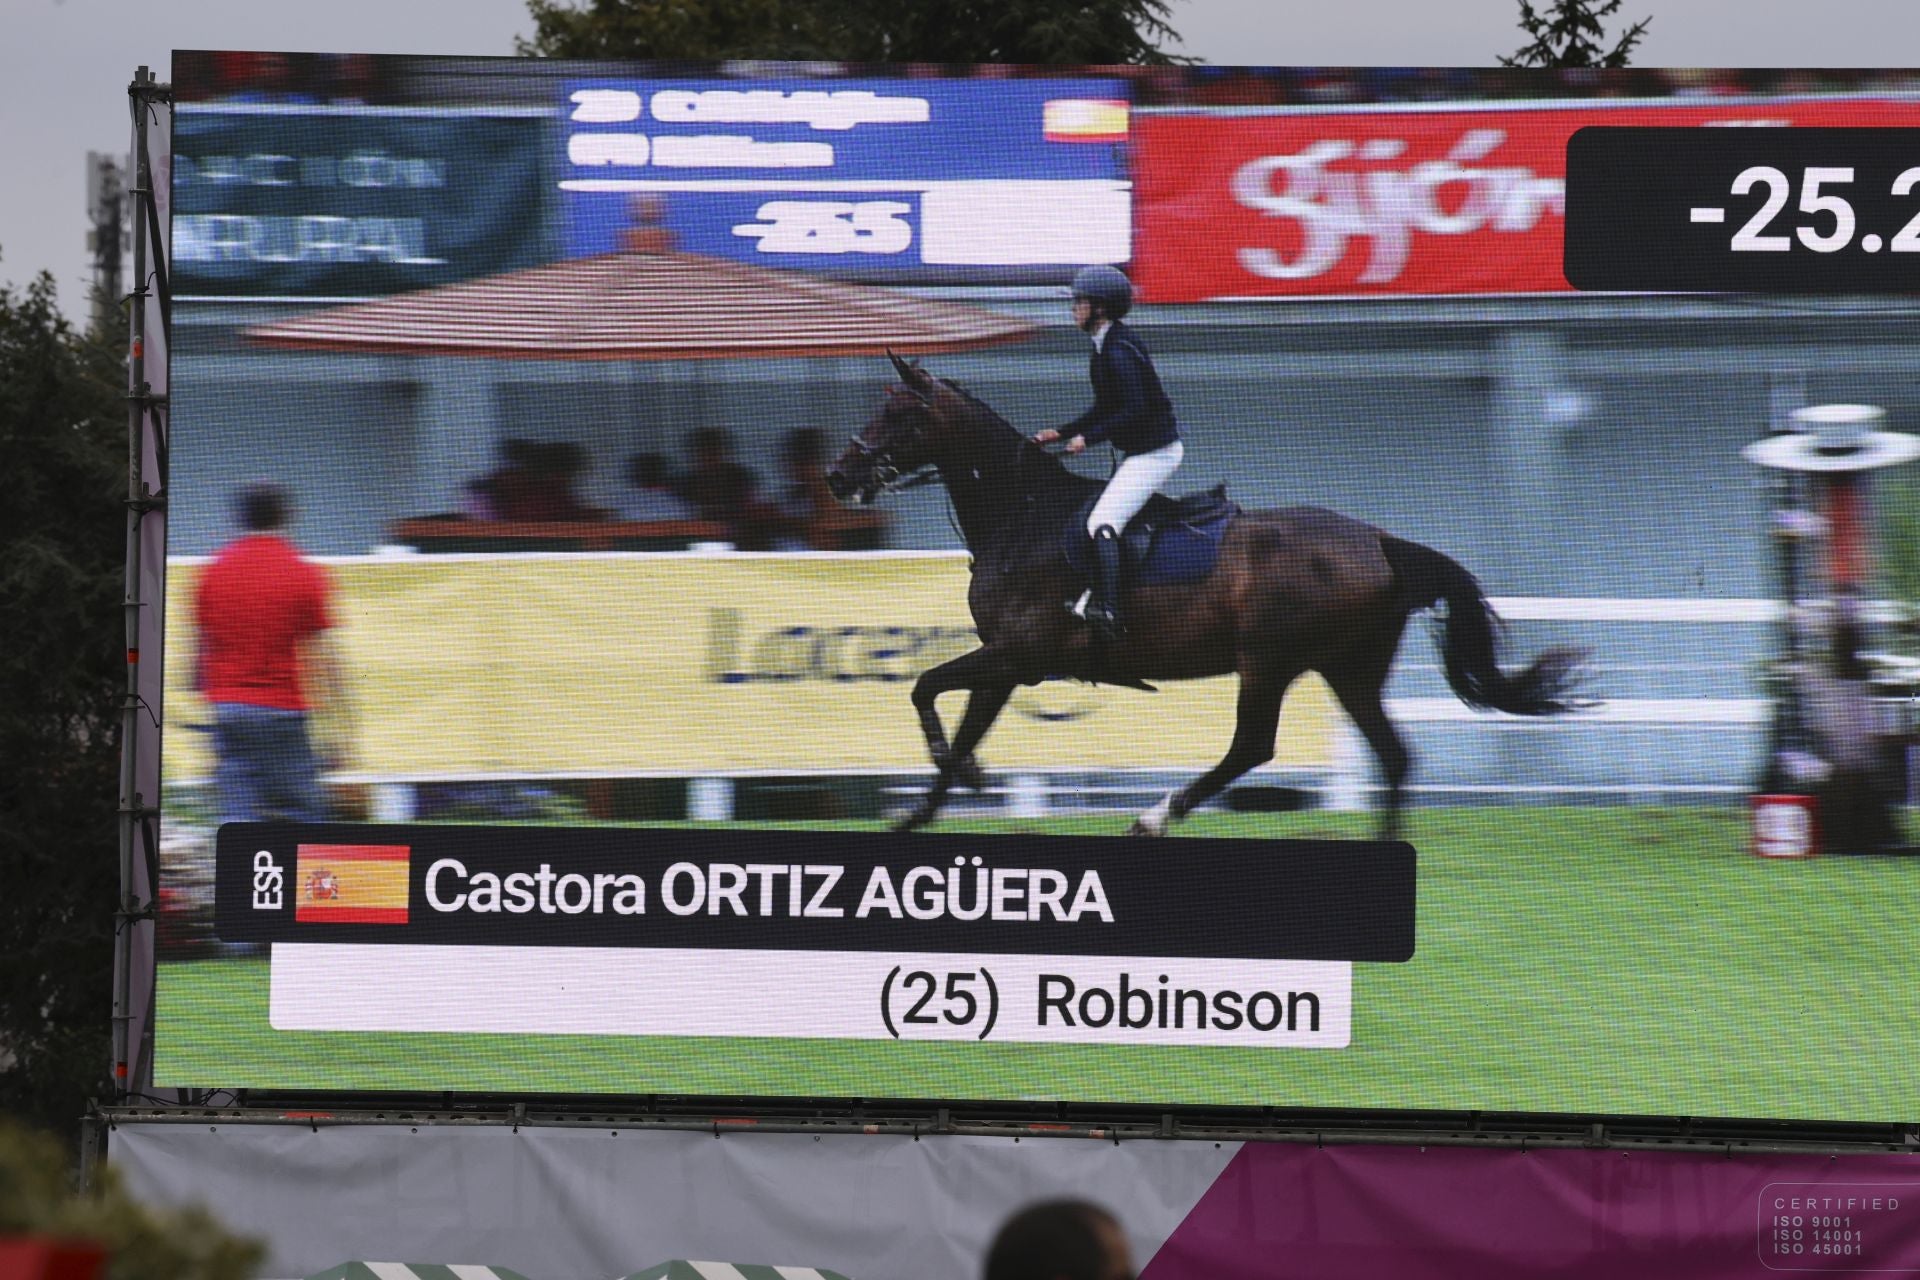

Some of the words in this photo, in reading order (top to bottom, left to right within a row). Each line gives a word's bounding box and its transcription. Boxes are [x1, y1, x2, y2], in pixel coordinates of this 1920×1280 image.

[252, 850, 284, 910] ESP
[424, 857, 647, 916] Castora
[660, 861, 846, 918] ORTIZ
[855, 854, 1116, 923] AGÜERA
[880, 965, 1000, 1040] (25)
[1037, 973, 1321, 1032] Robinson
[1774, 1198, 1899, 1210] CERTIFIED
[1773, 1215, 1803, 1227] ISO
[1812, 1216, 1851, 1228] 9001
[1773, 1229, 1803, 1241] ISO
[1813, 1230, 1863, 1242] 14001
[1774, 1243, 1804, 1254] ISO
[1812, 1244, 1862, 1255] 45001
